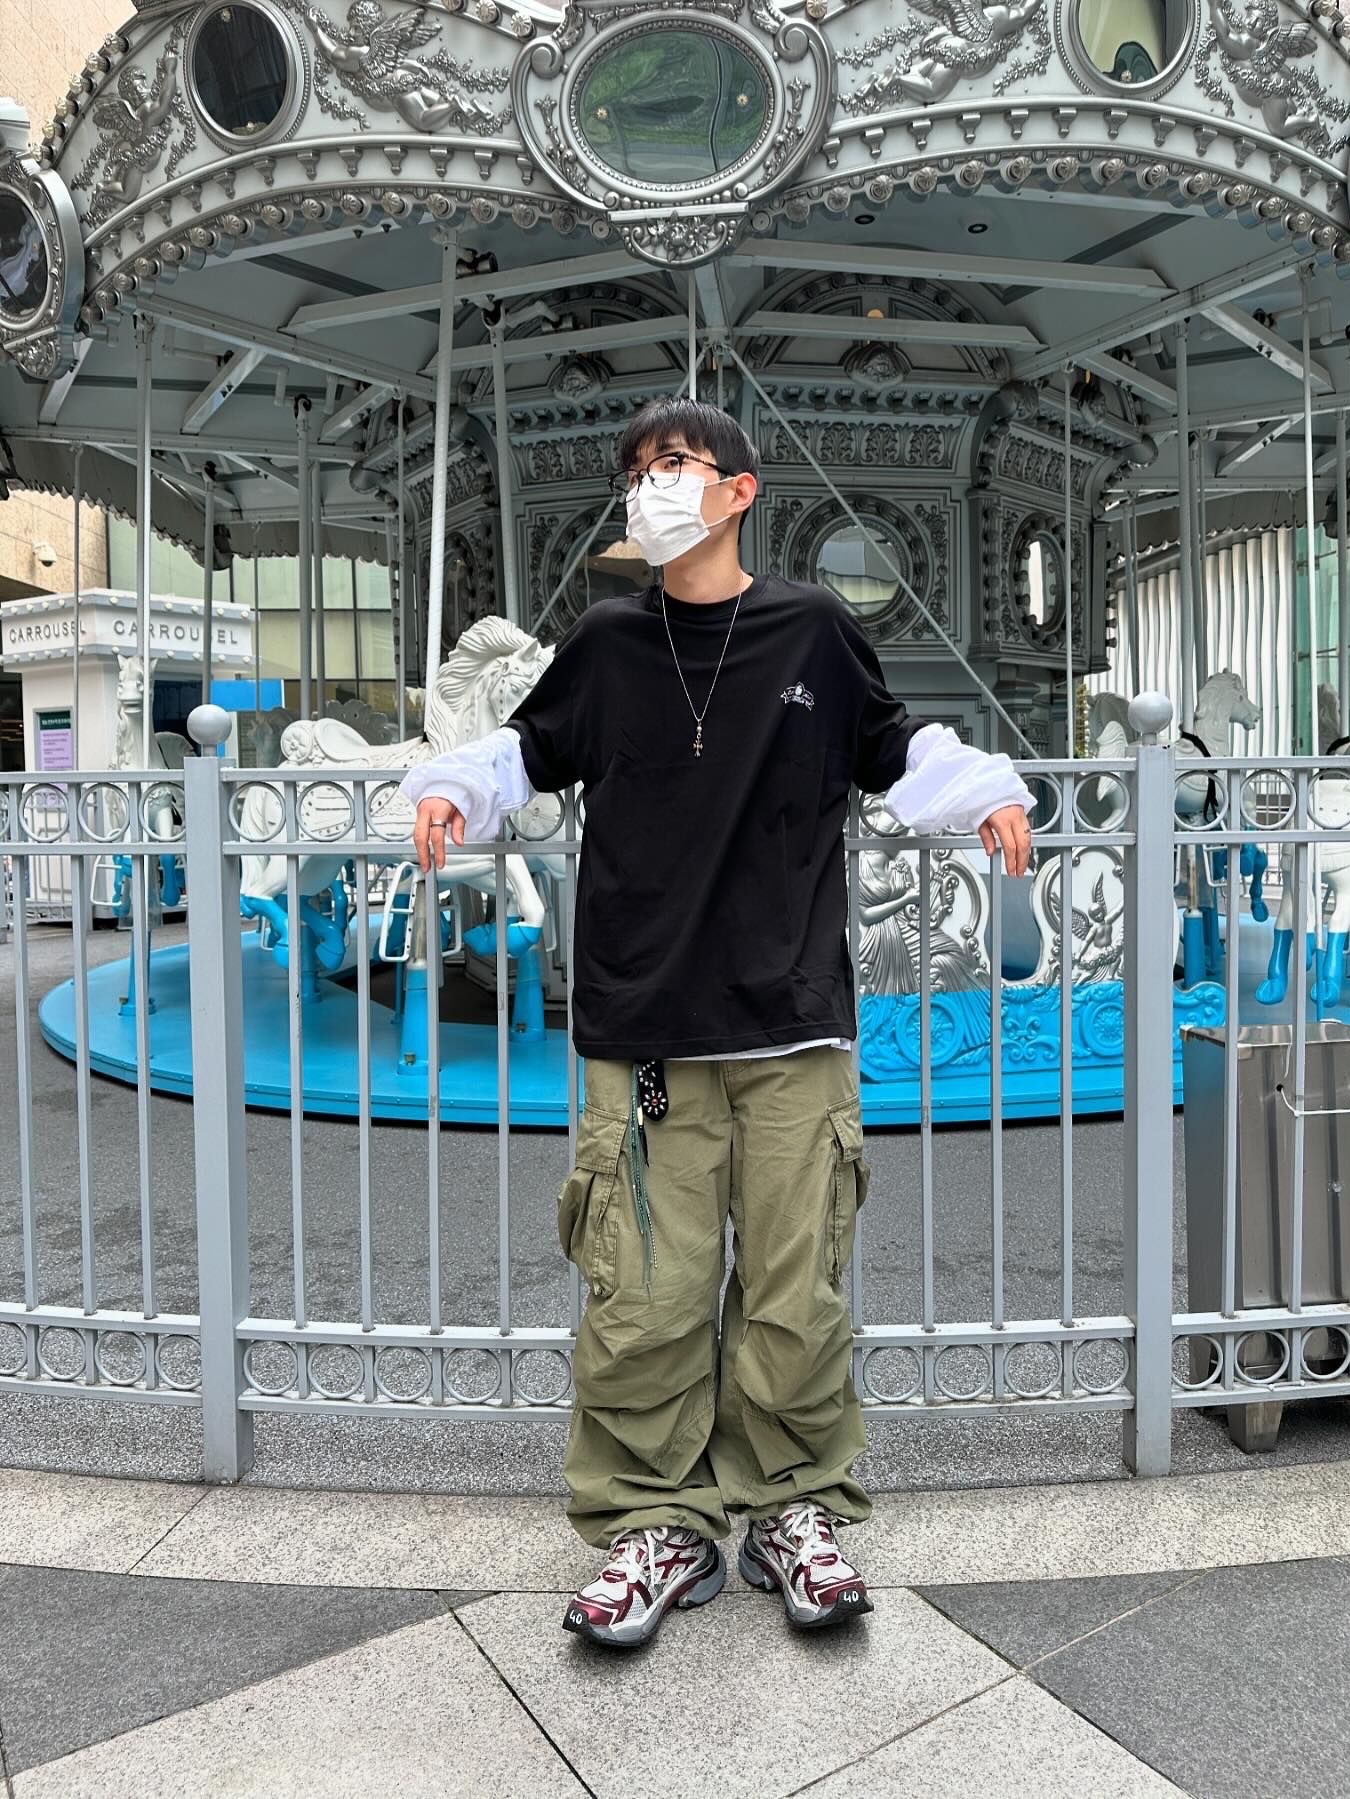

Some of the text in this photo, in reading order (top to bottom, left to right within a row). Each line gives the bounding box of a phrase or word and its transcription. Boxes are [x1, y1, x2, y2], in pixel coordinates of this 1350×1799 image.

[113, 620, 238, 645] CARROUEL
[844, 1590, 860, 1603] 40
[569, 1609, 583, 1625] 40
